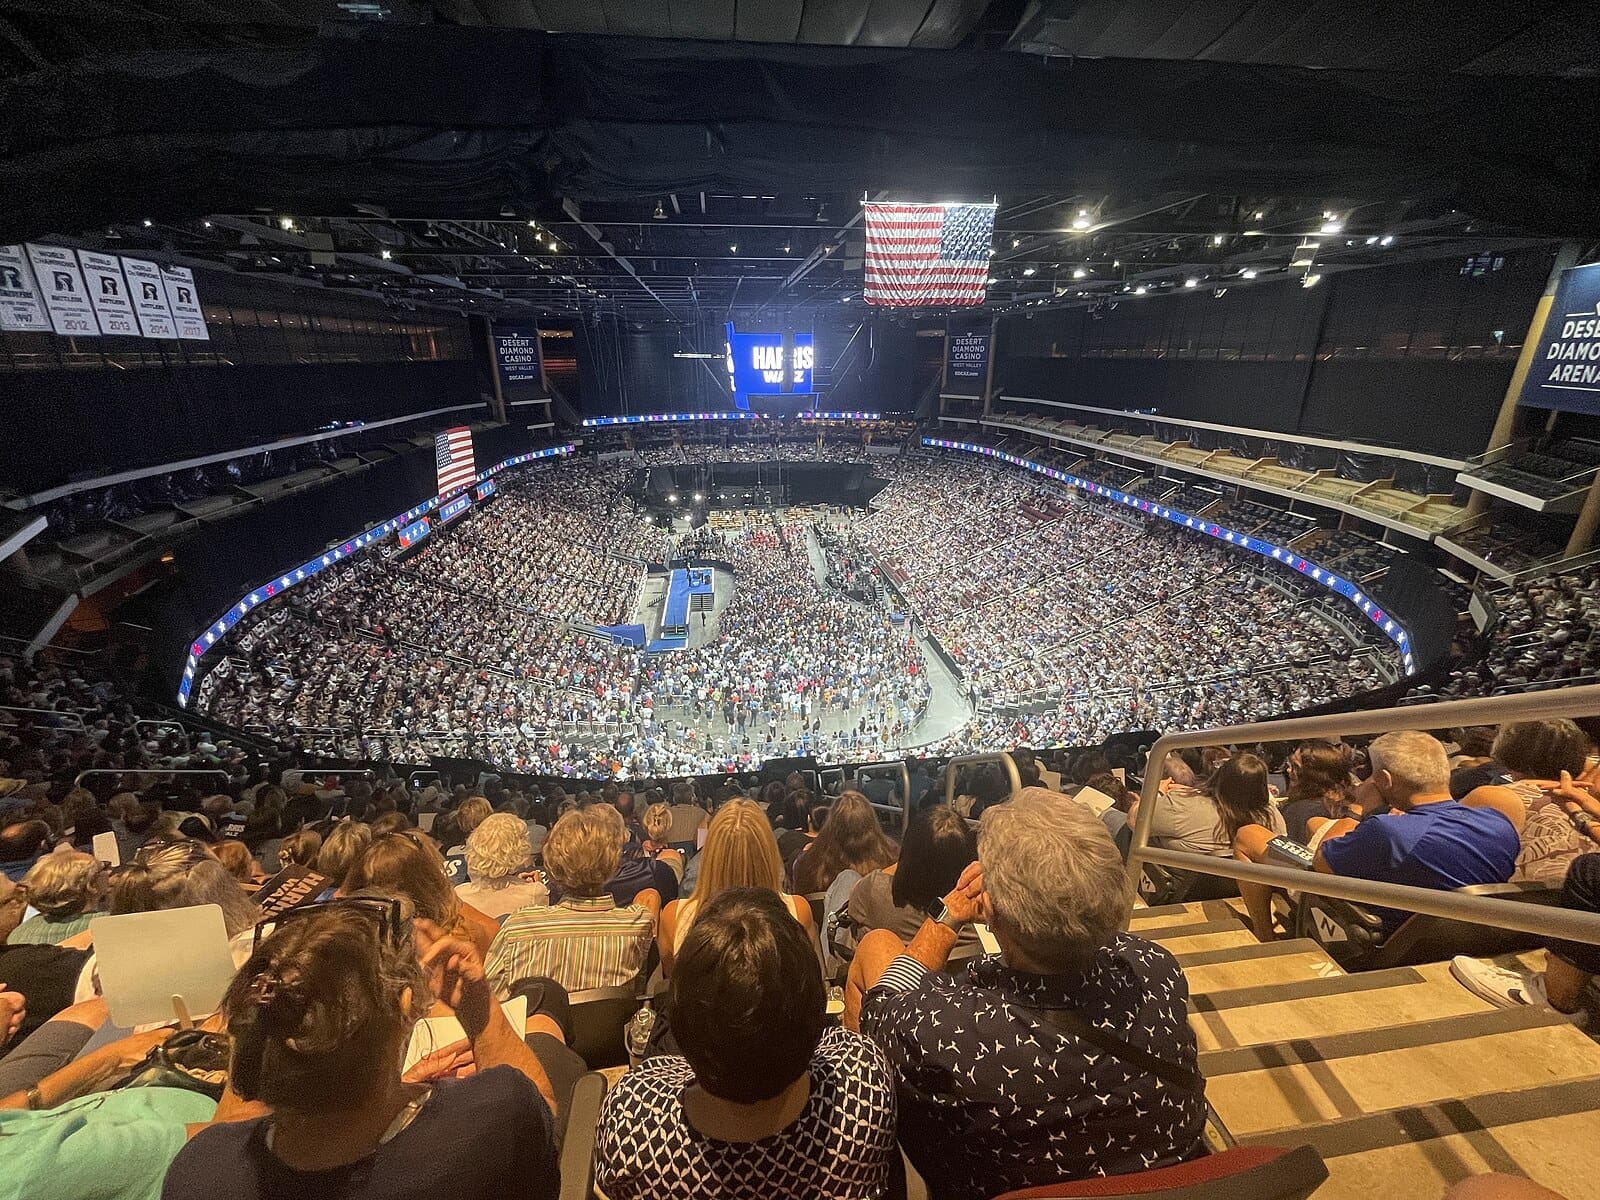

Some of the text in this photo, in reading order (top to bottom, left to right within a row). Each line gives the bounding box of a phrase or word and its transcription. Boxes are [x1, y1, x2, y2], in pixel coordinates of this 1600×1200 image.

[64, 320, 90, 330] 2012
[109, 320, 130, 331] 2013
[150, 324, 169, 334] 2014
